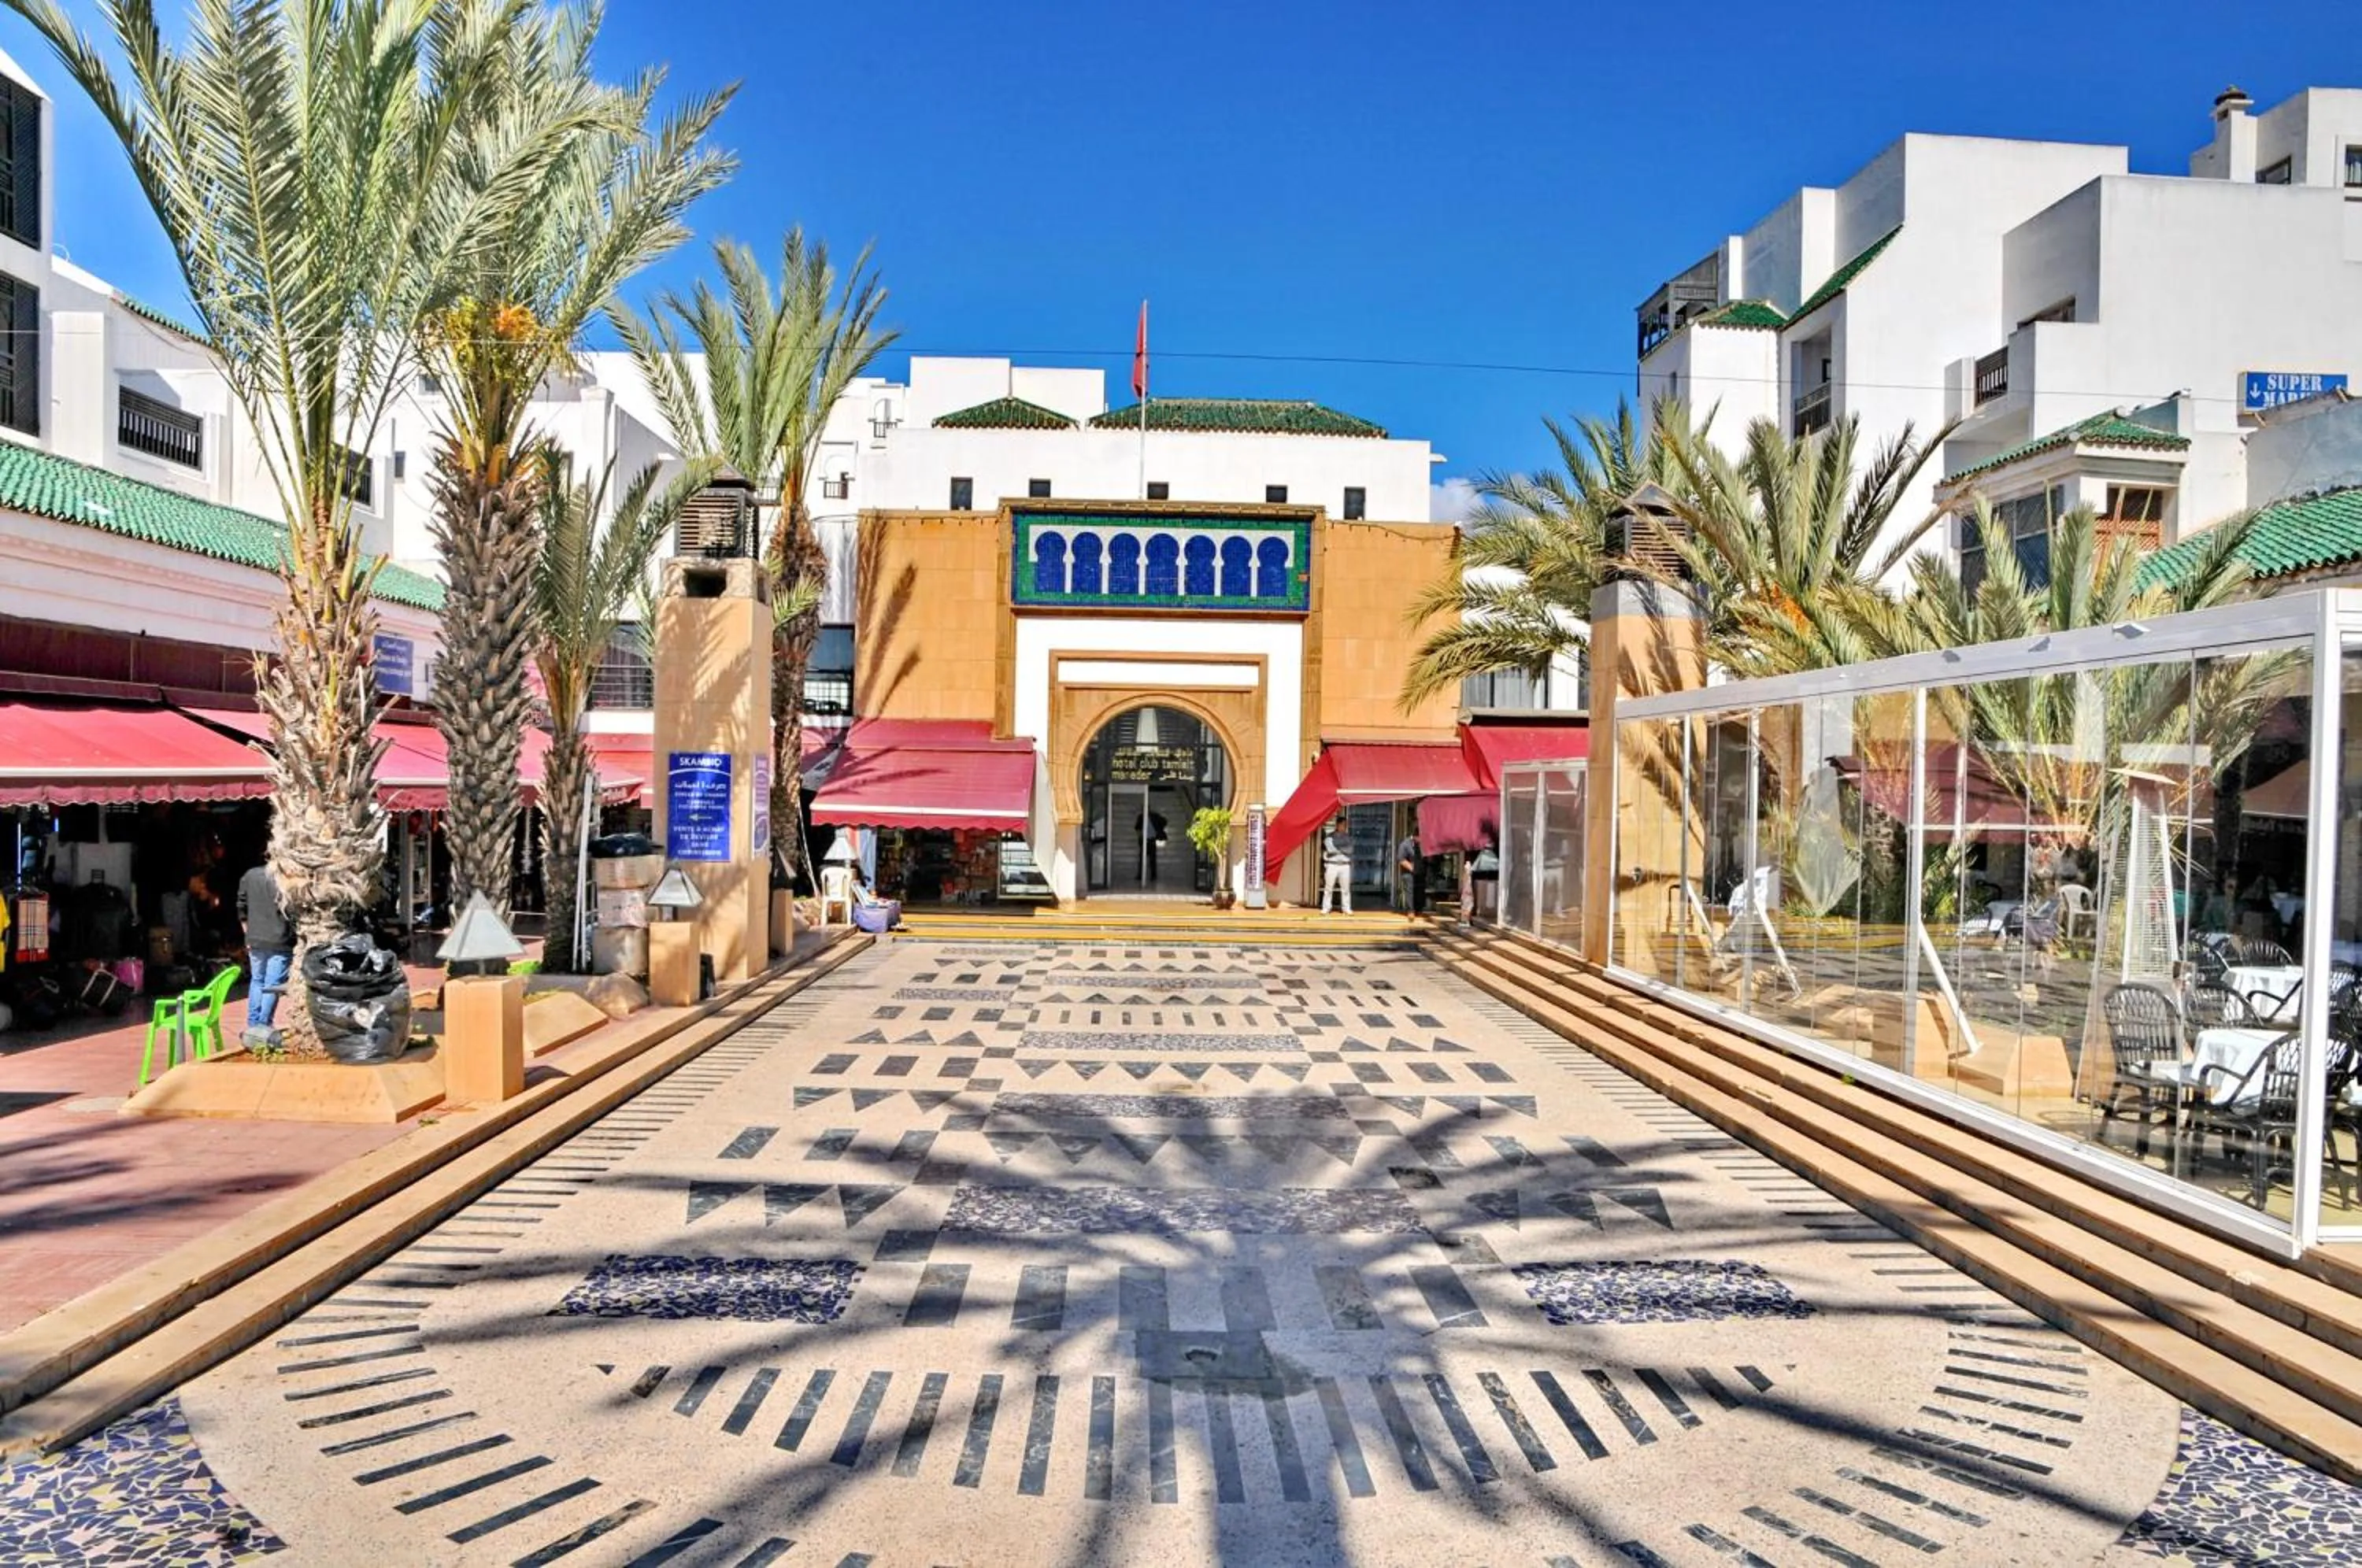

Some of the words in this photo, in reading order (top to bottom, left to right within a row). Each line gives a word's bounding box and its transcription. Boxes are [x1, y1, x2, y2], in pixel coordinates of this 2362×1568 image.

[2267, 374, 2322, 391] SUPER
[2263, 391, 2311, 407] MAR
[679, 756, 722, 767] SKAMBIO
[1112, 756, 1136, 769] hotel
[1139, 756, 1158, 769] club
